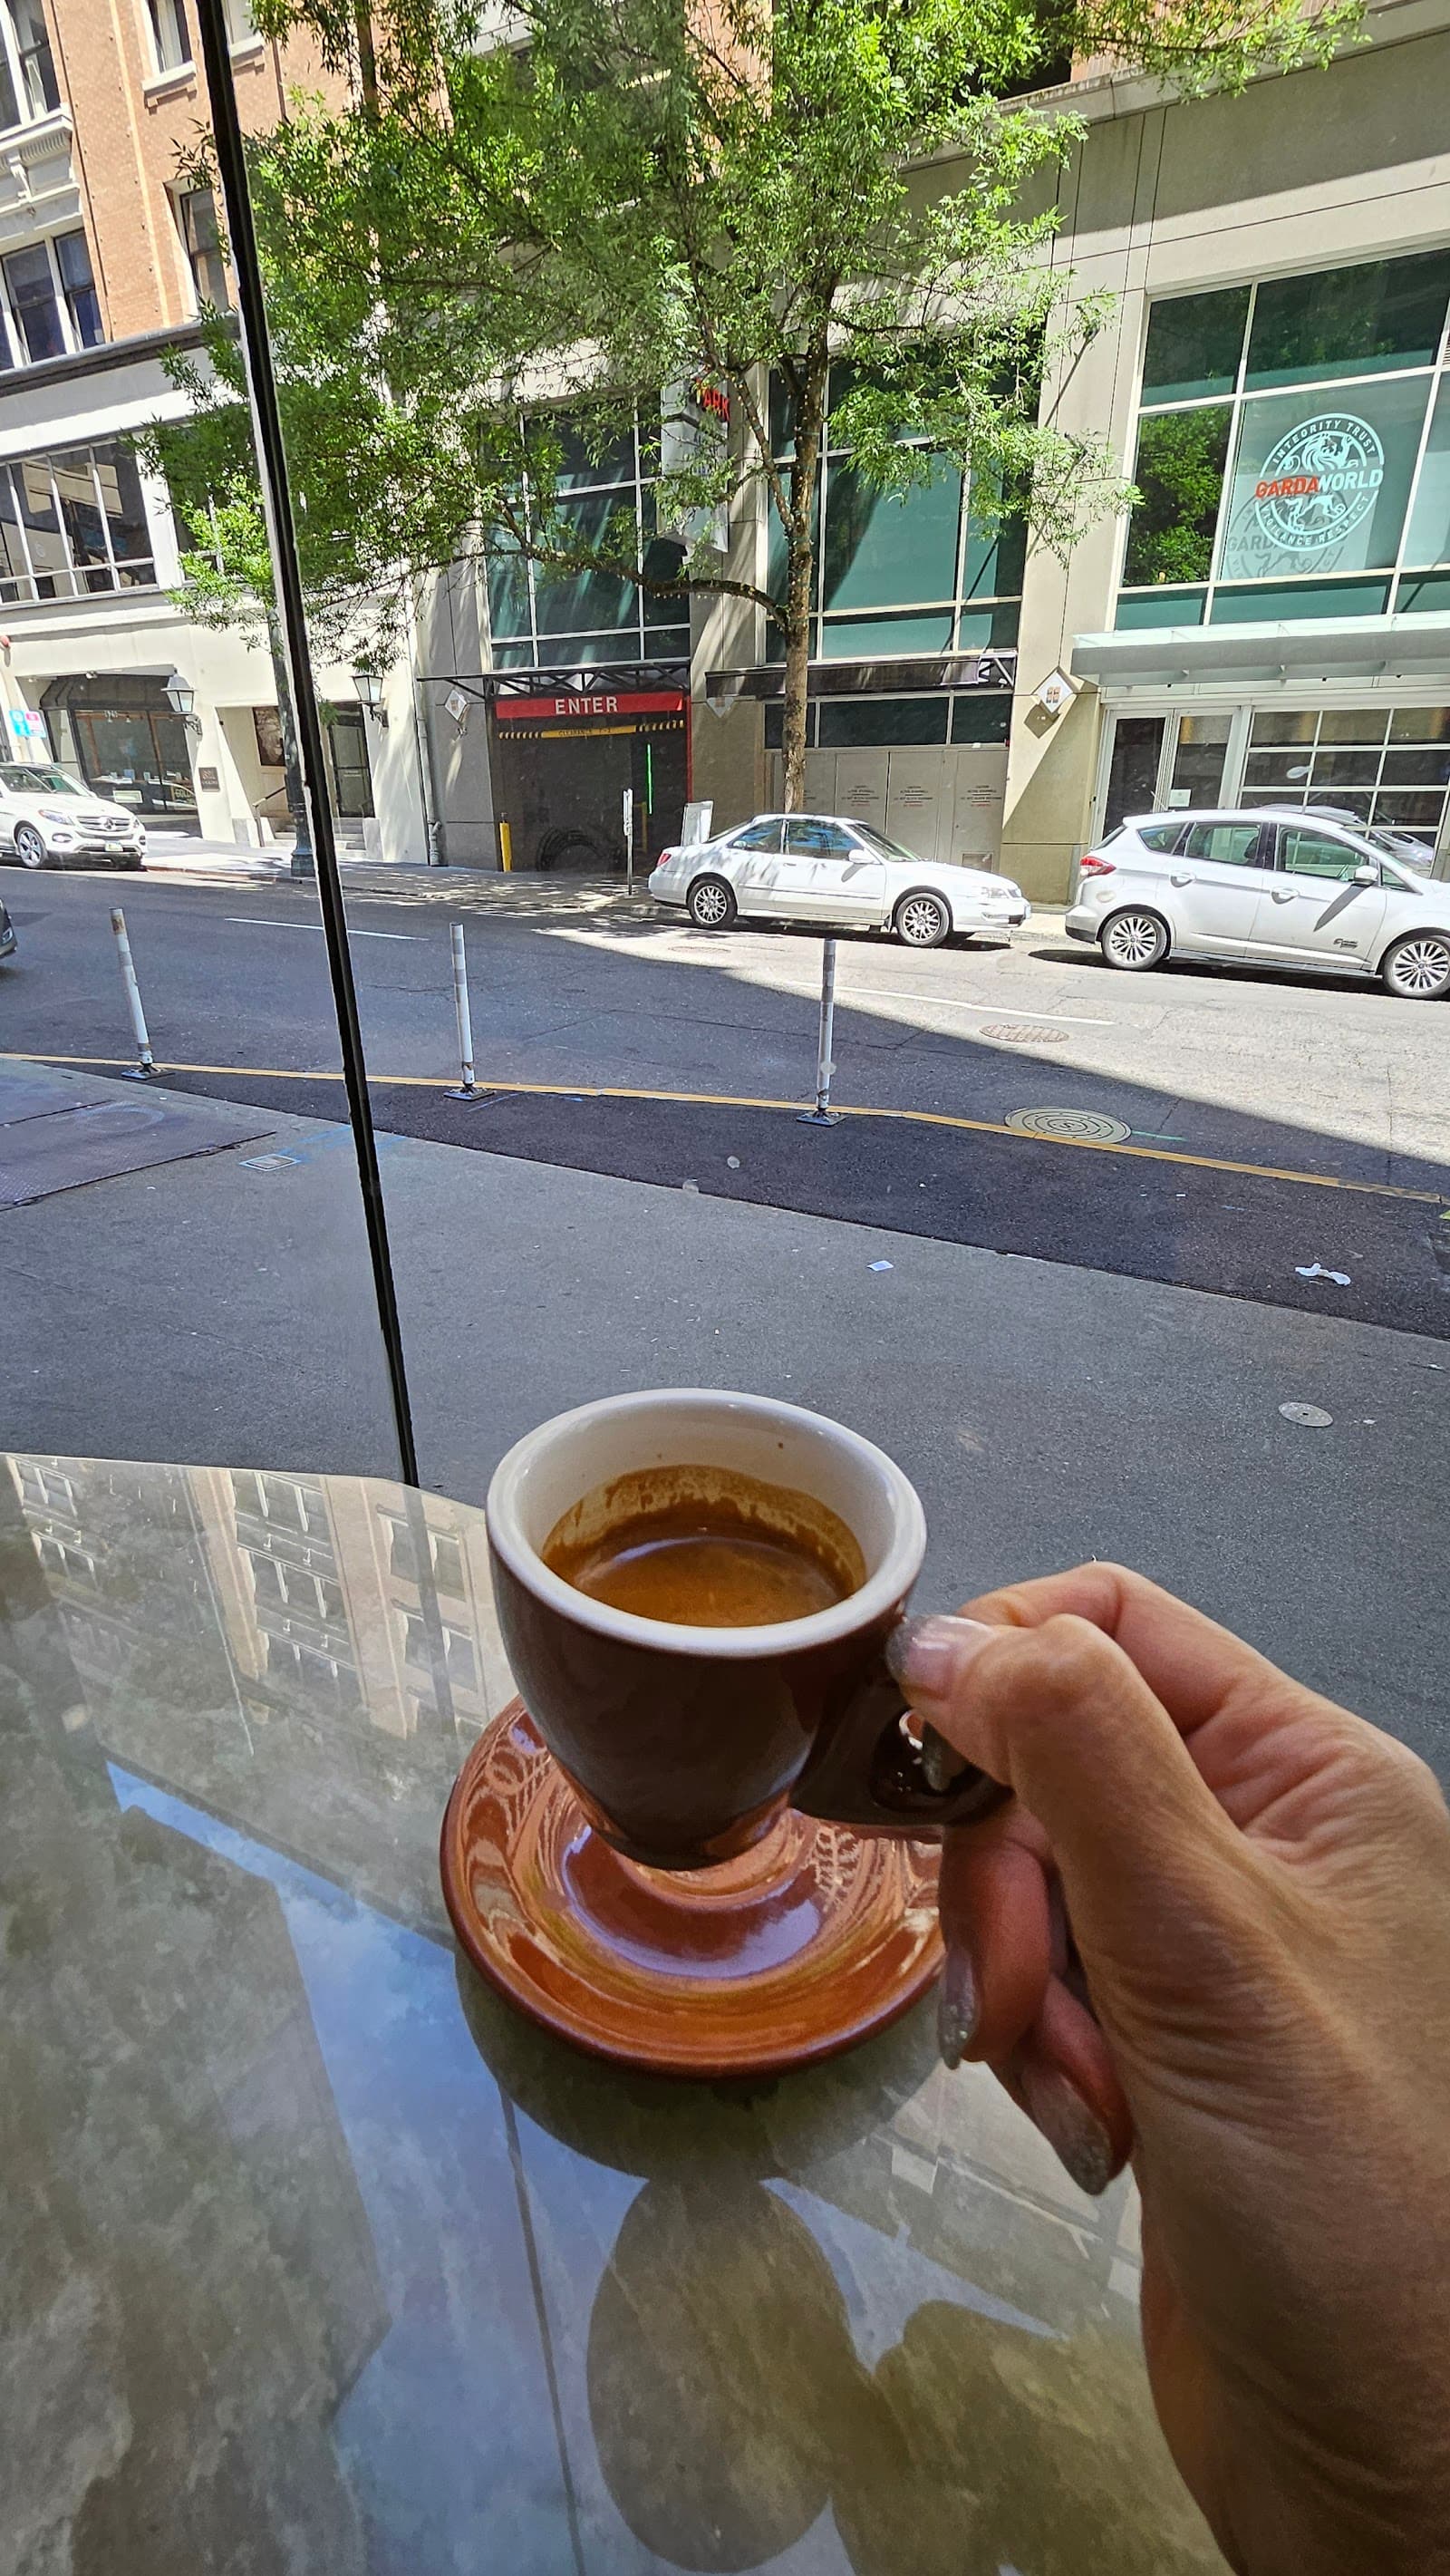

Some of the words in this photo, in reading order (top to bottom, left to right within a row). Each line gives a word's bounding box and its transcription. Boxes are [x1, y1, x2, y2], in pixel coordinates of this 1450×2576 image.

[695, 378, 730, 421] ARK
[1346, 421, 1376, 454] TRUST
[1318, 496, 1371, 543] RESPECT
[555, 696, 618, 714] ENTER
